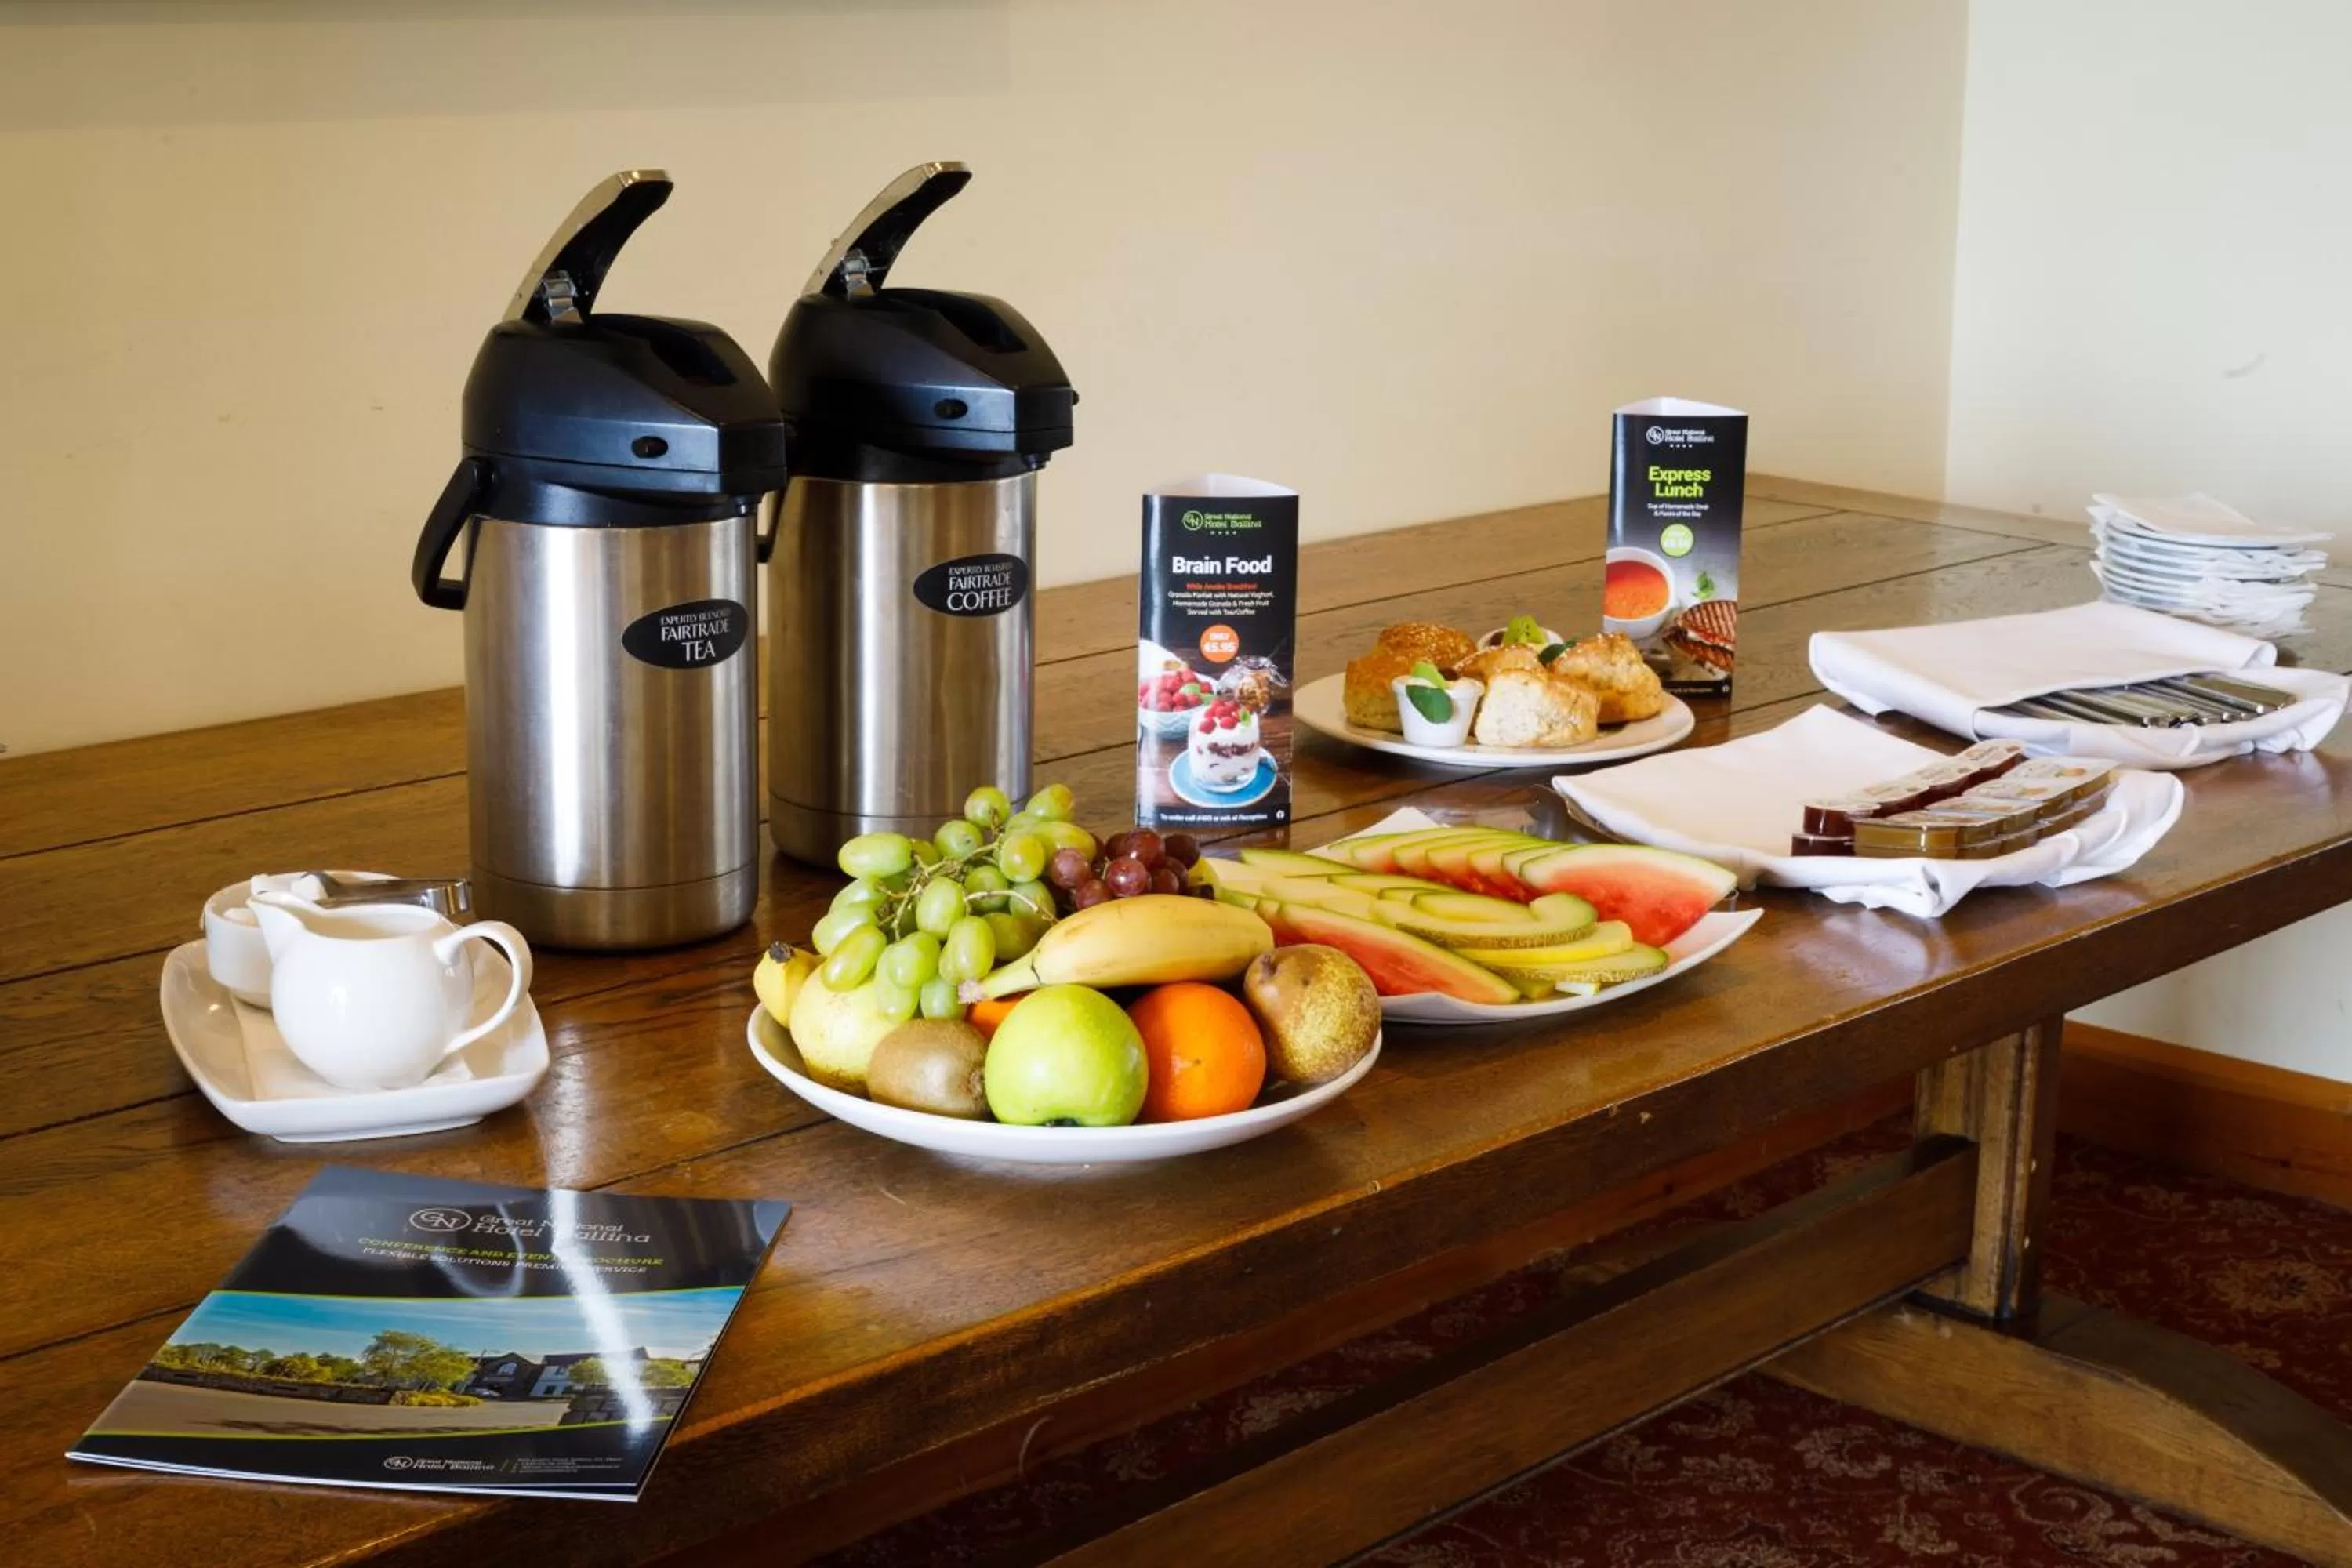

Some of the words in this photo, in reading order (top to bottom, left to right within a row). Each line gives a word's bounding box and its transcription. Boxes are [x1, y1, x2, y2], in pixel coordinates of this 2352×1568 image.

[1648, 466, 1711, 484] Express
[1655, 482, 1703, 497] Lunch
[1171, 556, 1221, 574] Brain
[1225, 555, 1272, 574] Food
[949, 572, 1012, 590] FAIRTRADE
[947, 588, 1012, 612] COFFEE
[661, 618, 731, 641] FAIRTRADE
[681, 640, 716, 662] TEA
[471, 1222, 544, 1237] Hotel
[558, 1228, 652, 1243] allina
[478, 1214, 537, 1227] Great
[541, 1219, 625, 1232] Nional
[358, 1237, 468, 1256] CONFERENCE
[468, 1248, 503, 1259] AND
[571, 1254, 665, 1265] OCHURE
[363, 1247, 429, 1261] FLEXIBLE
[586, 1264, 648, 1274] ERVICE
